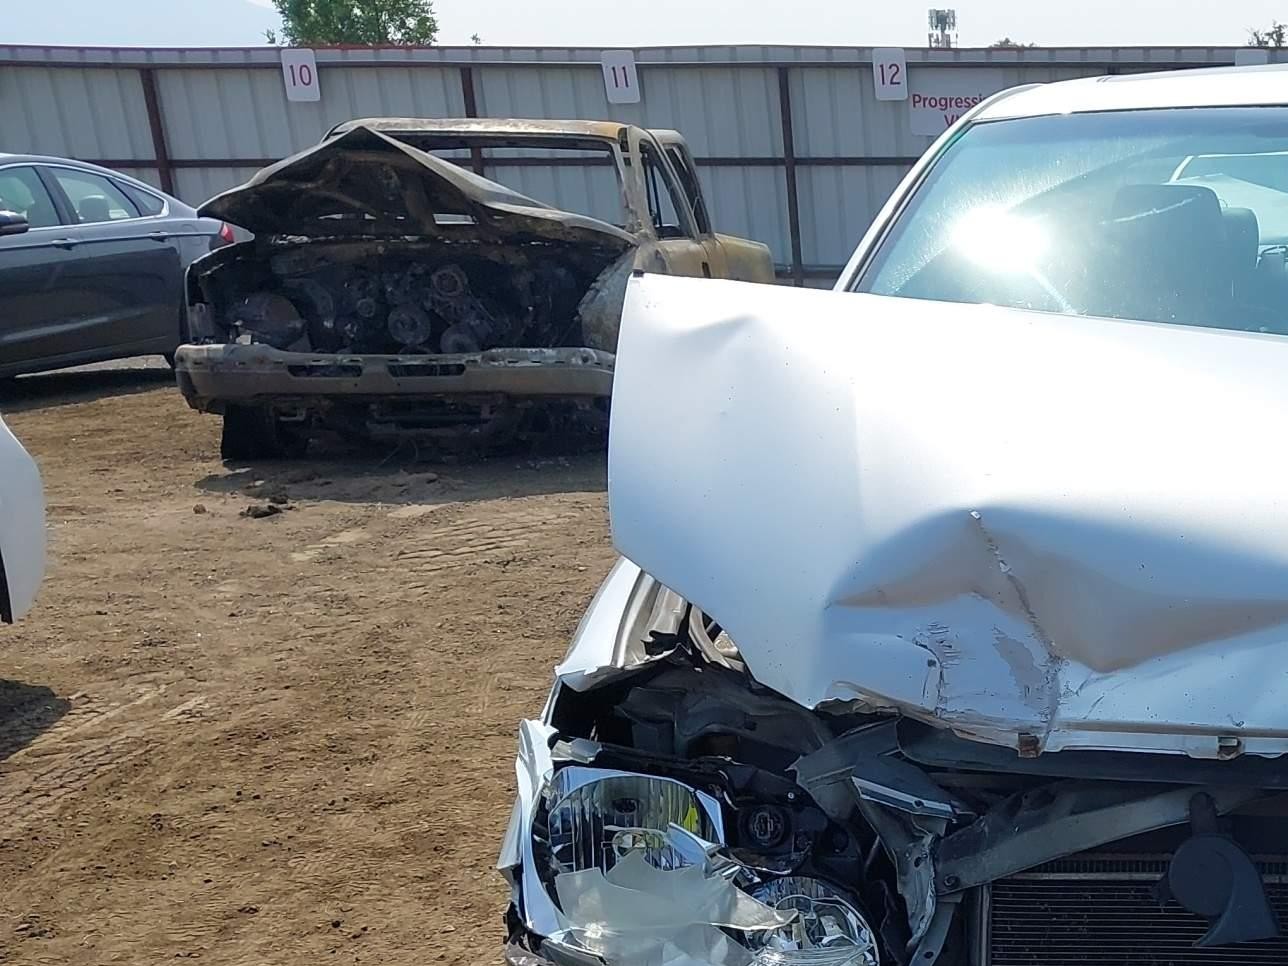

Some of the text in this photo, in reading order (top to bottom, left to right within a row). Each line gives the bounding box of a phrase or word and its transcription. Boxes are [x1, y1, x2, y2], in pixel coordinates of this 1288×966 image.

[289, 64, 312, 87] 10
[611, 66, 629, 88] 11
[879, 63, 901, 86] 12
[912, 93, 987, 111] Progressi
